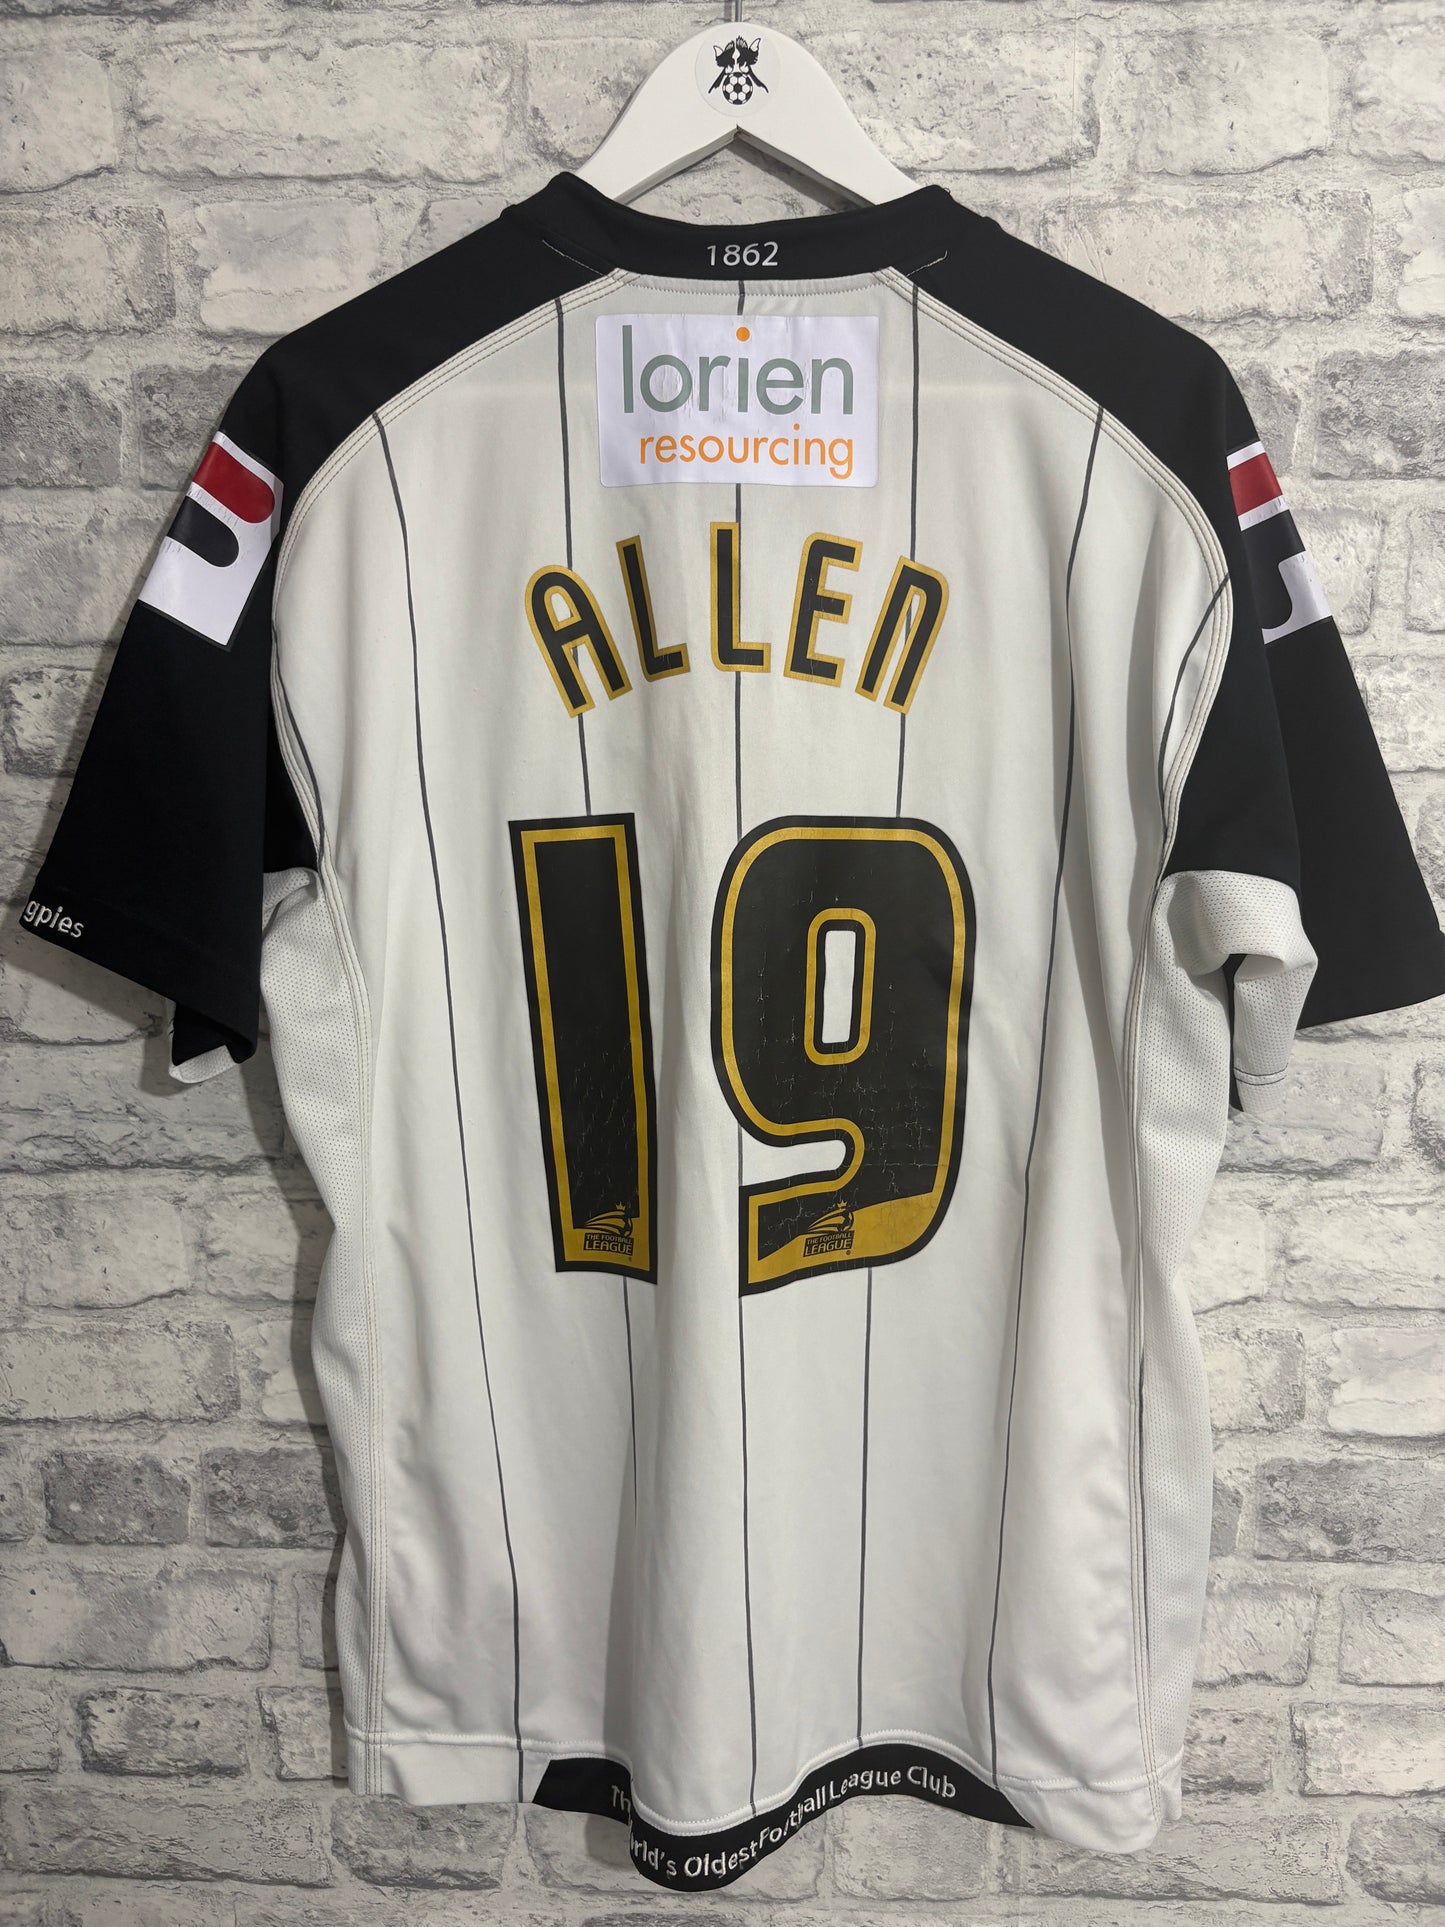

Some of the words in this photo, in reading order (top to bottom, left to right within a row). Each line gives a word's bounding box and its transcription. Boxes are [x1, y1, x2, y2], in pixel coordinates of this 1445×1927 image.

[706, 241, 779, 267] 1862
[622, 325, 854, 415] lorien
[639, 423, 854, 480] resourcing
[525, 522, 950, 718] ALLEN
[23, 900, 85, 938] gpies
[508, 812, 977, 1298] 19
[585, 1241, 633, 1255] LEAGUE
[601, 1234, 633, 1245] FOOTBALL
[804, 1238, 852, 1257] LEAGUE
[819, 1232, 853, 1243] FOOTBALL
[611, 1784, 632, 1815] Th
[630, 1830, 678, 1877] rld's
[683, 1839, 759, 1879] Oldest
[829, 1769, 902, 1801] League
[906, 1765, 957, 1799] Club
